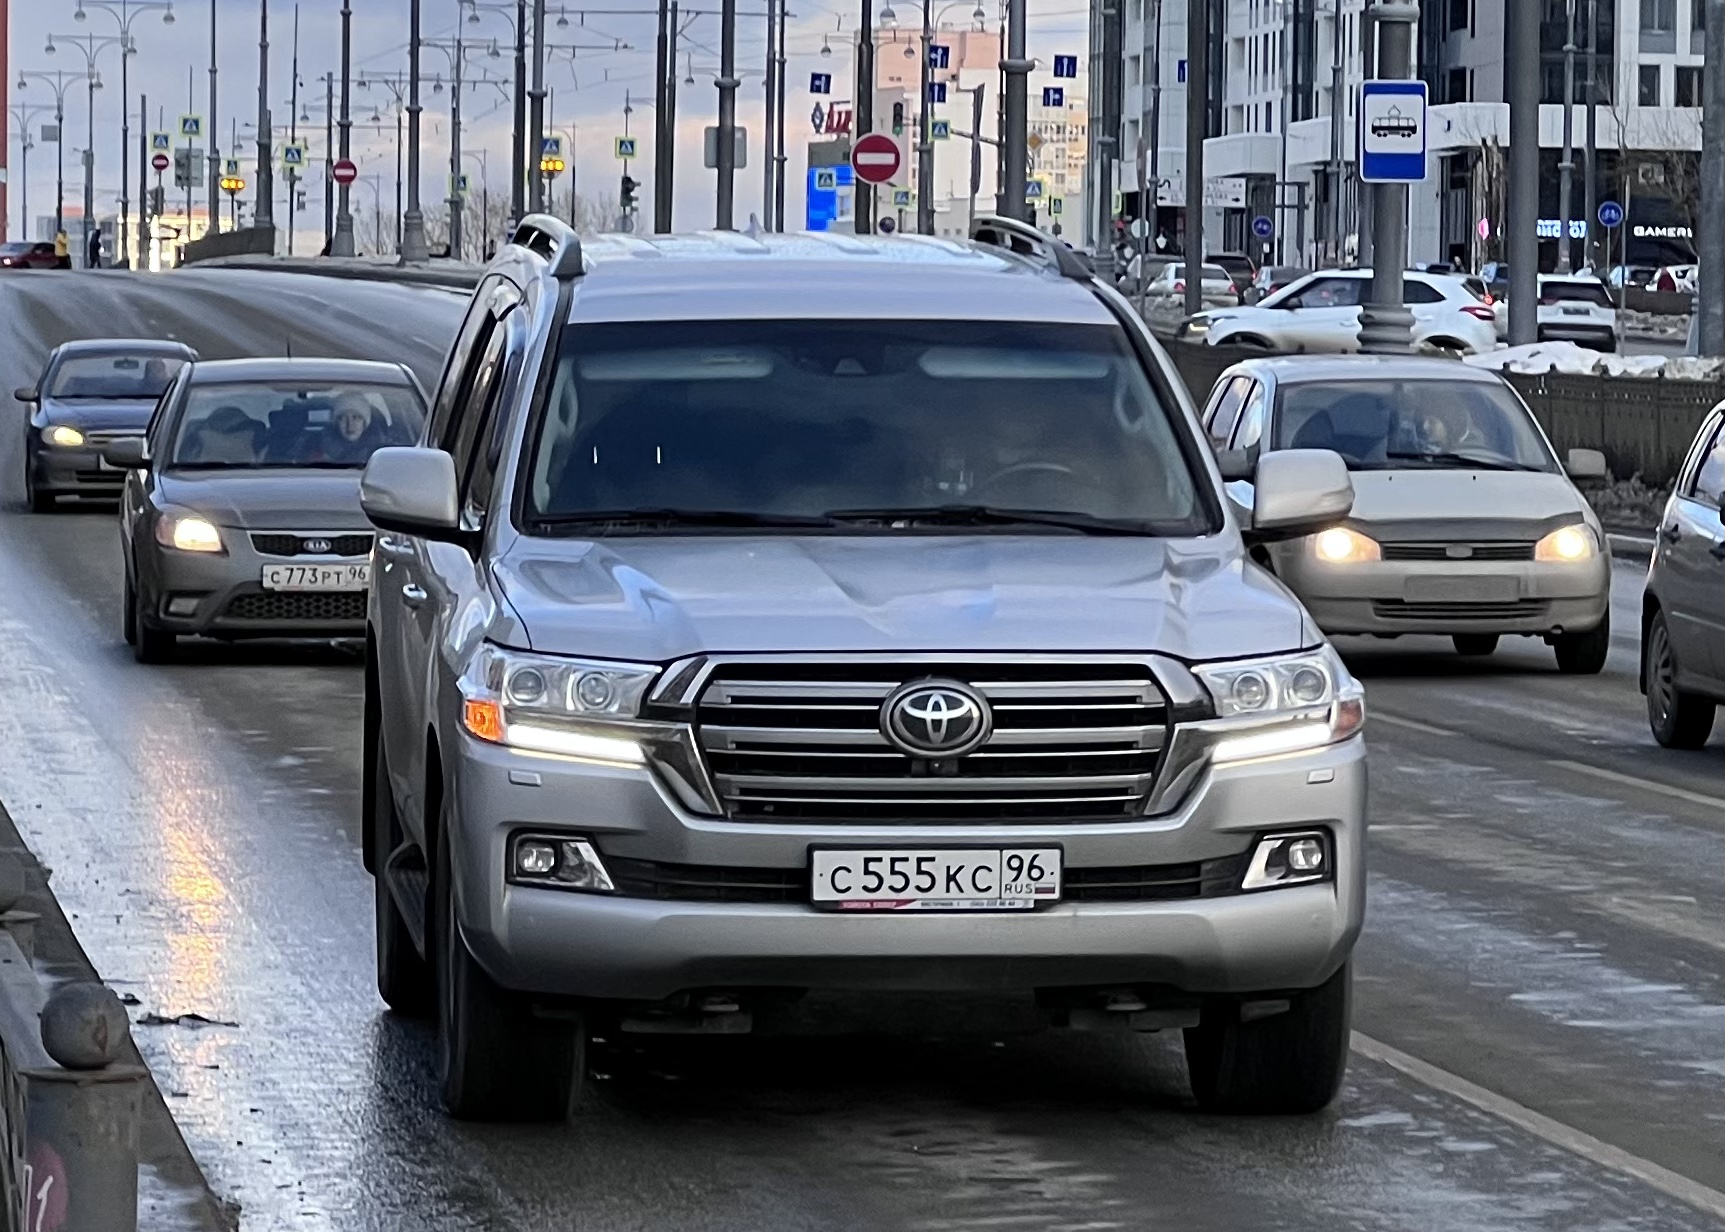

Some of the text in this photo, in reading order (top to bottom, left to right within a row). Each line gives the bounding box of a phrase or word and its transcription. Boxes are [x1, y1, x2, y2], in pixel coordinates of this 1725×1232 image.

[307, 540, 328, 550] KIA
[270, 566, 366, 585] С773РТ 96
[830, 854, 1045, 894] С555КС 96
[1004, 883, 1033, 894] RUS
